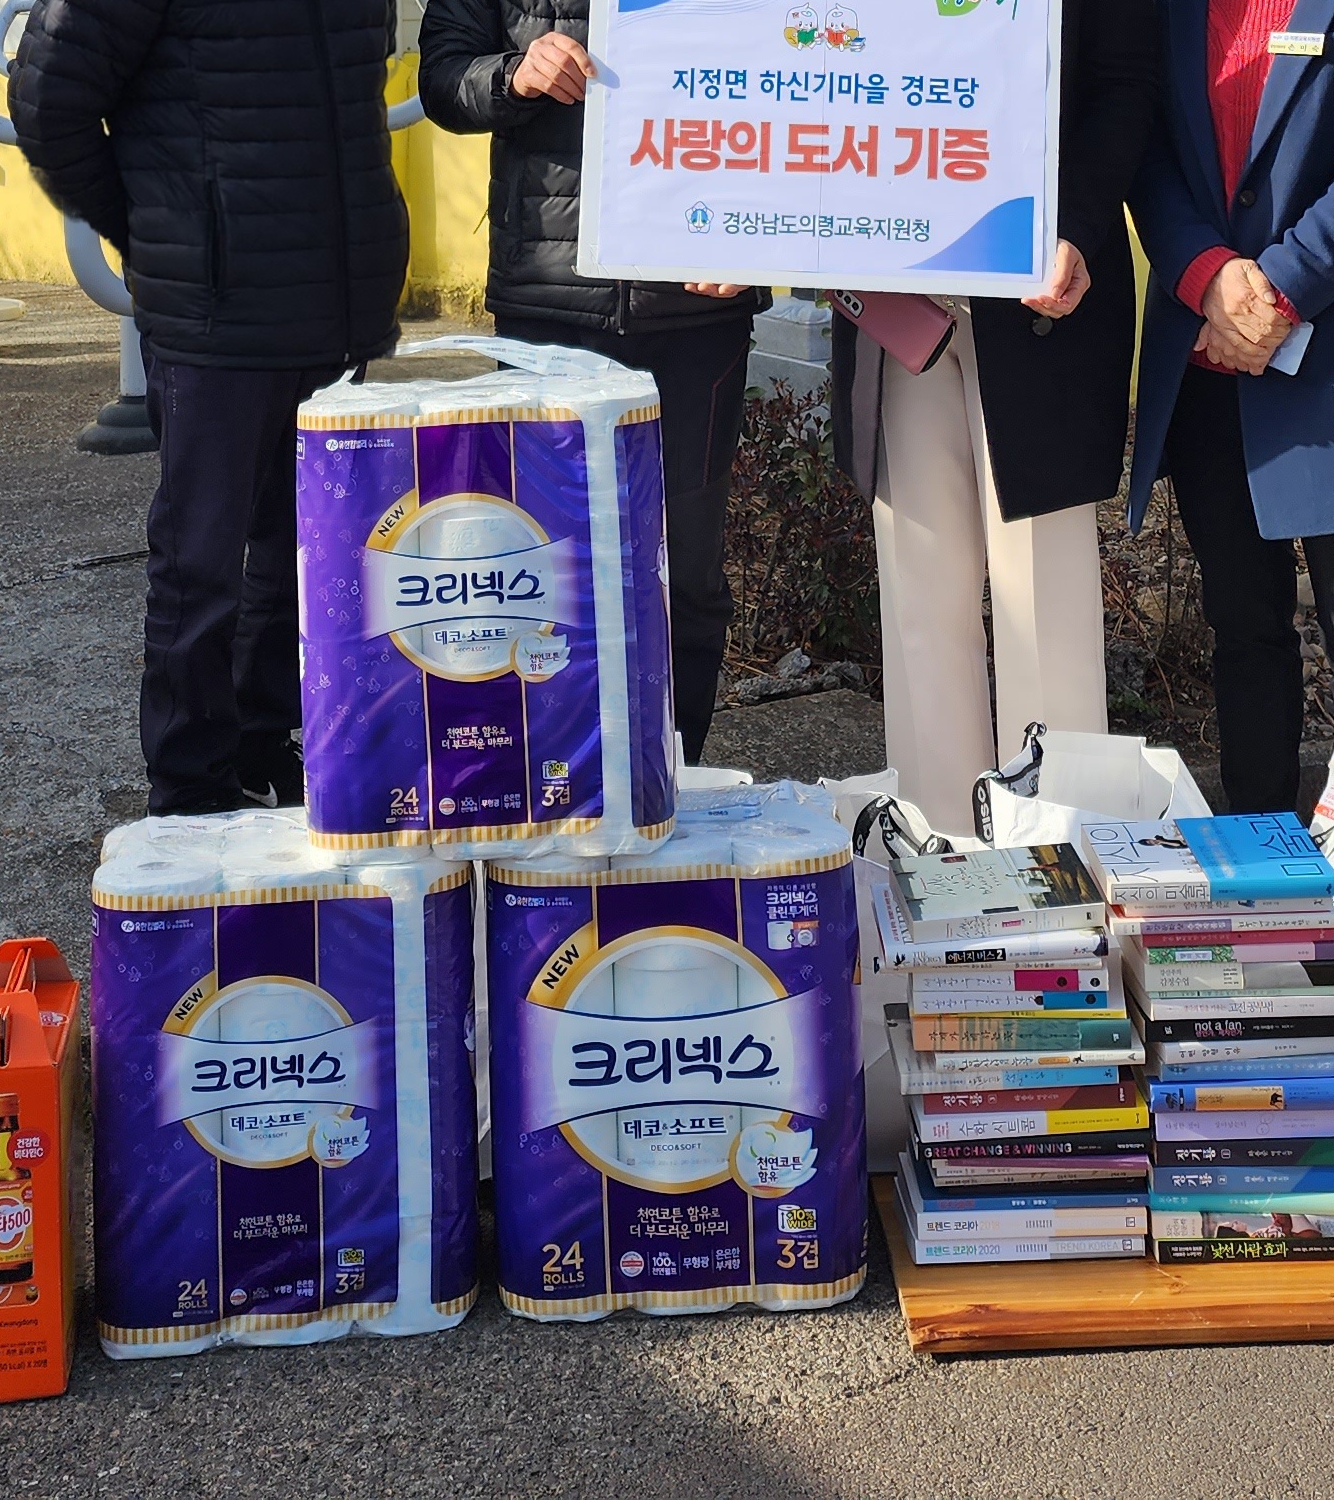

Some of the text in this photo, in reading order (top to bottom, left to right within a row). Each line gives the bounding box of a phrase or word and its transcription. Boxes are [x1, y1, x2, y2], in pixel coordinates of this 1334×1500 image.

[671, 68, 980, 109] 지정면 하신기마을 경로당
[629, 117, 991, 182] 사랑의 도서 기증
[723, 210, 931, 242] 경상남도의령교육지원청
[377, 504, 406, 538] NEW
[395, 568, 545, 608] 크리넥스
[433, 625, 509, 646] 데코&소프트
[447, 726, 507, 739] 천연코튼 함유로
[441, 736, 513, 750] 더 부드러운 마무리
[389, 787, 420, 807] 24
[541, 785, 570, 807] 3겹
[390, 805, 419, 816] ROLLS
[765, 890, 819, 906] 크리넥스
[1113, 884, 1210, 901] 지식의 미술관
[766, 905, 819, 919] 클린투게더
[947, 950, 975, 963] 에너지
[541, 943, 581, 990] NEW
[1160, 977, 1190, 987] 감정수업
[174, 986, 206, 1022] NEW
[1194, 1019, 1246, 1031] not a fan.
[568, 1034, 780, 1087] 크리넥스
[191, 1050, 347, 1094] 크리넥스
[943, 1092, 983, 1108] 정기룡
[230, 1113, 308, 1132] 데코&소프트
[623, 1116, 727, 1140] 데코&소프트
[959, 1117, 1037, 1137] 수학 시트콤
[17, 1137, 41, 1148] 건강한
[650, 1143, 702, 1152] DECO&SOFT
[924, 1146, 962, 1158] GREAT
[963, 1144, 1010, 1157] CHANGE
[1022, 1142, 1073, 1154] WINNING
[14, 1147, 44, 1159] 비타민C
[1175, 1146, 1217, 1162] 정기룡
[756, 1156, 803, 1171] 천연코튼
[757, 1171, 779, 1184] 함유
[1171, 1172, 1228, 1188] 정기룡 2
[239, 1213, 302, 1230] 천연코튼 함유로
[637, 1206, 721, 1224] 천연코튼 함유로
[233, 1223, 308, 1241] 더 부드러운 마무리
[629, 1220, 730, 1240] 더 부드러운 마무리
[787, 1219, 815, 1229] WIDE
[926, 1222, 952, 1232] 트렌드
[953, 1222, 979, 1231] 코리아
[715, 1247, 741, 1260] 은은한
[776, 1238, 819, 1269] 3겹
[925, 1244, 1001, 1257] 트렌드 코리아 2020
[1055, 1240, 1120, 1251] TREND KOREA
[1211, 1241, 1235, 1260] 낯선
[1236, 1241, 1262, 1258] 사람
[1264, 1240, 1287, 1258] 효과
[541, 1241, 584, 1273] 24
[651, 1256, 677, 1267] 100%
[682, 1256, 710, 1270] 무형광
[334, 1271, 365, 1294] 3겹
[542, 1270, 585, 1286] ROLLS
[177, 1279, 208, 1301] 24
[178, 1299, 208, 1309] ROLLS
